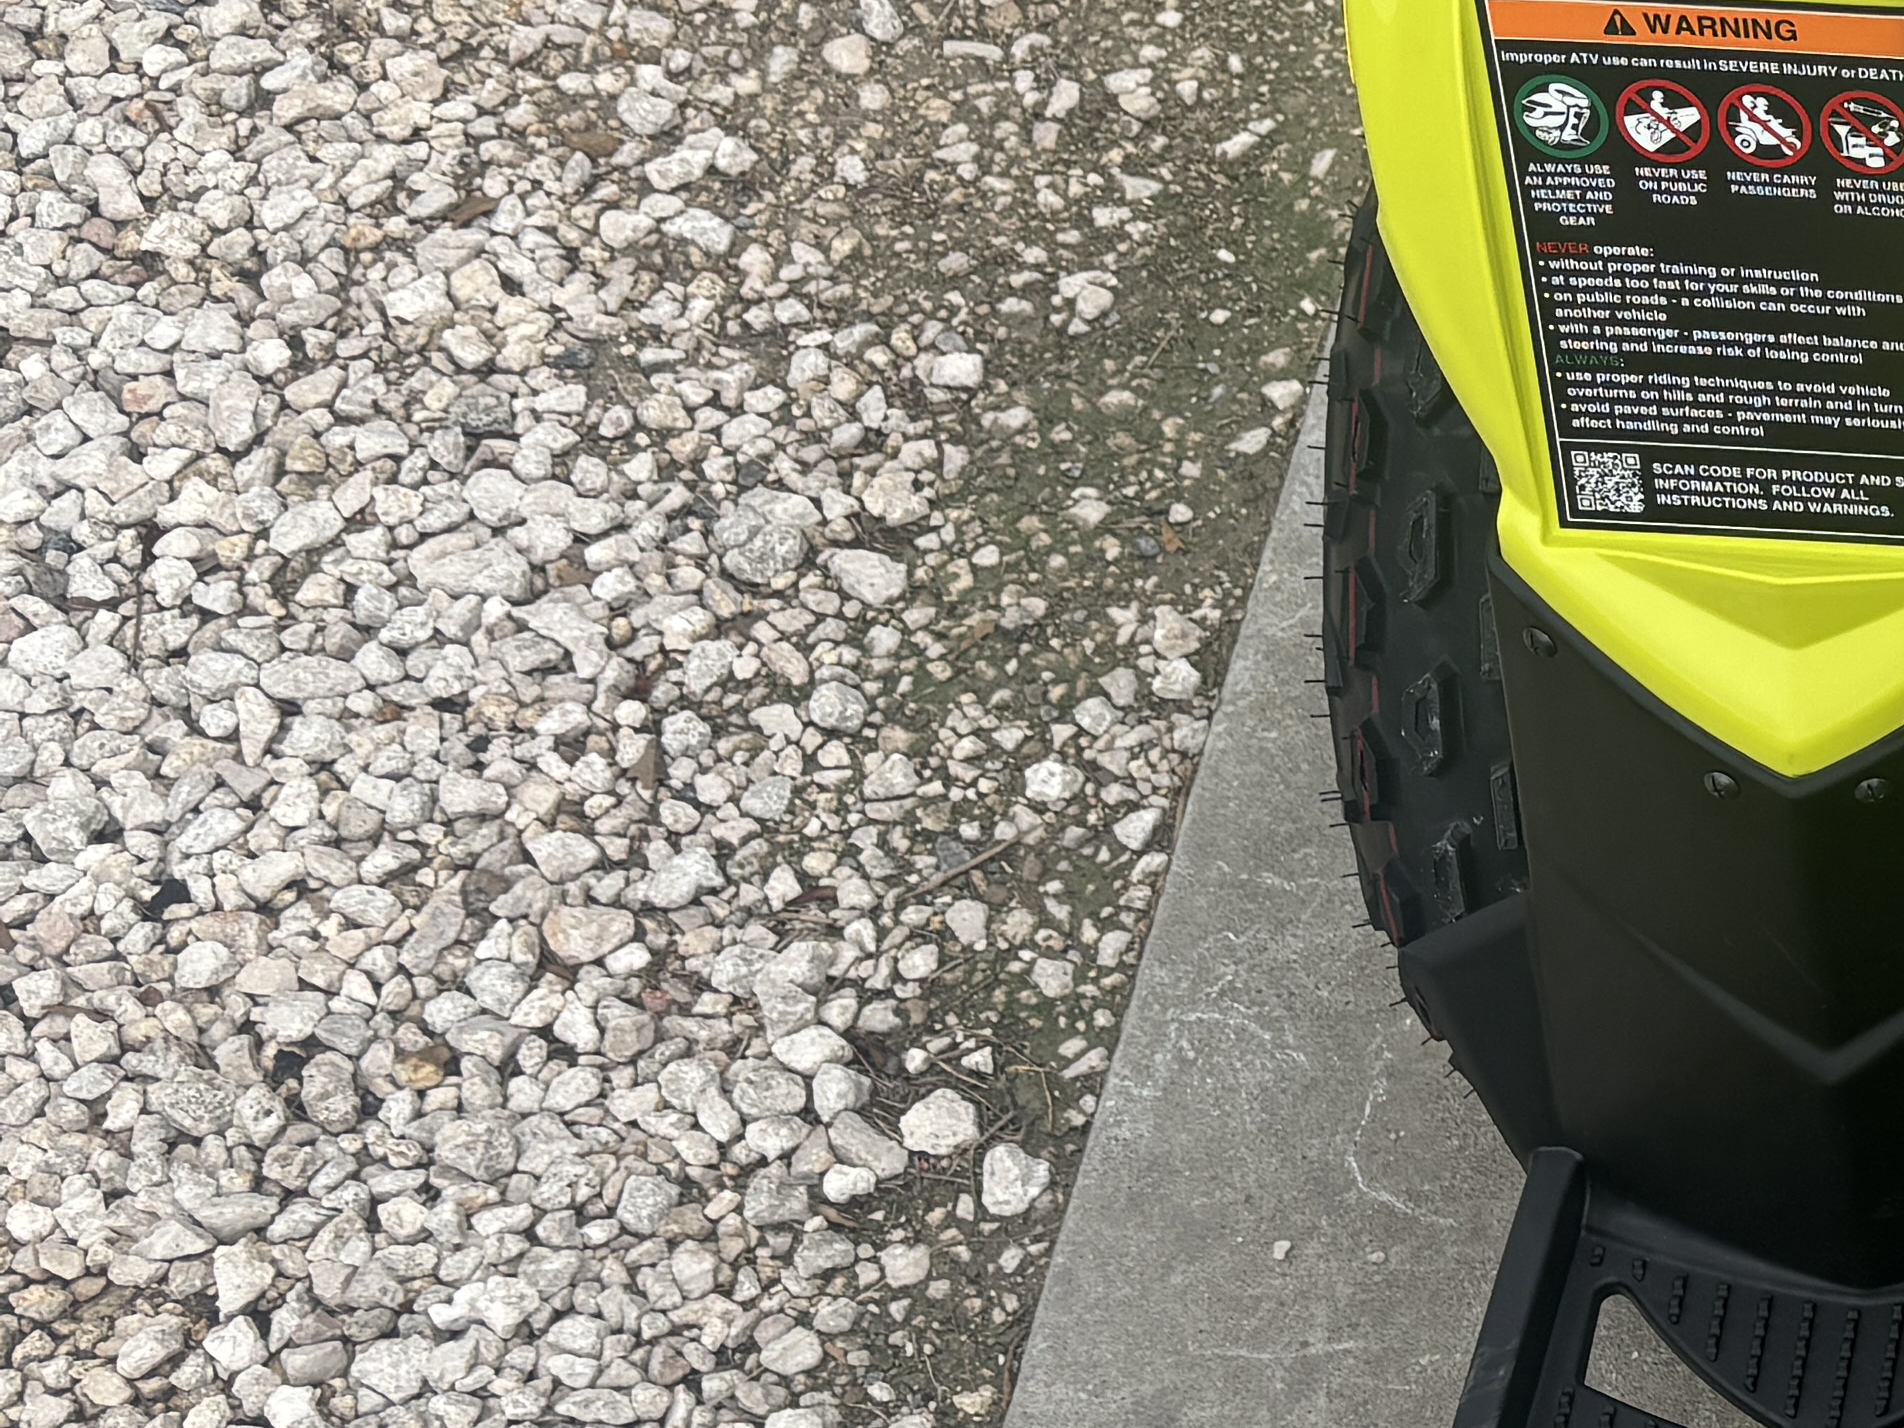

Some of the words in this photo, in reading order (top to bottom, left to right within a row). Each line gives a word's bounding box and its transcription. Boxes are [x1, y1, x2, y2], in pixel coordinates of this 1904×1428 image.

[1642, 11, 1798, 42] WARNING
[1500, 49, 1566, 65] Improper
[1569, 51, 1599, 64] ATV
[1601, 55, 1629, 66] use
[1630, 57, 1657, 67] can
[1659, 57, 1701, 70] result
[1702, 58, 1718, 71] in
[1718, 59, 1780, 74] SEVERE
[1781, 62, 1838, 77] INJURY
[1840, 68, 1856, 78] or
[1535, 241, 1589, 253] NEVER
[1592, 245, 1654, 258] operate:
[1547, 257, 1604, 271] without
[1606, 261, 1656, 275] proper
[1659, 261, 1717, 279] training
[1720, 266, 1735, 277] or
[1739, 265, 1819, 282] instruction
[1550, 274, 1565, 286] at
[1568, 274, 1622, 289] speeds
[1624, 276, 1650, 289] too
[1652, 277, 1681, 290] fast
[1683, 278, 1704, 291] for
[1706, 282, 1739, 295] your
[1741, 282, 1777, 295] skills
[1779, 286, 1795, 297] or
[1798, 285, 1823, 298] the
[1826, 289, 1903, 304] conditions
[1651, 462, 1695, 476] SCAN
[1698, 464, 1742, 478] CODE
[1745, 466, 1778, 480] FOR
[1781, 468, 1855, 484] PRODUCT
[1859, 473, 1892, 487] AND
[1653, 477, 1764, 495] INFORMATION.
[1771, 483, 1836, 499] FOLLOW
[1839, 487, 1869, 501] ALL
[1655, 493, 1768, 510] INSTRUCTIONS
[1771, 499, 1804, 512] AND
[1806, 500, 1894, 517] WARNINGS.
